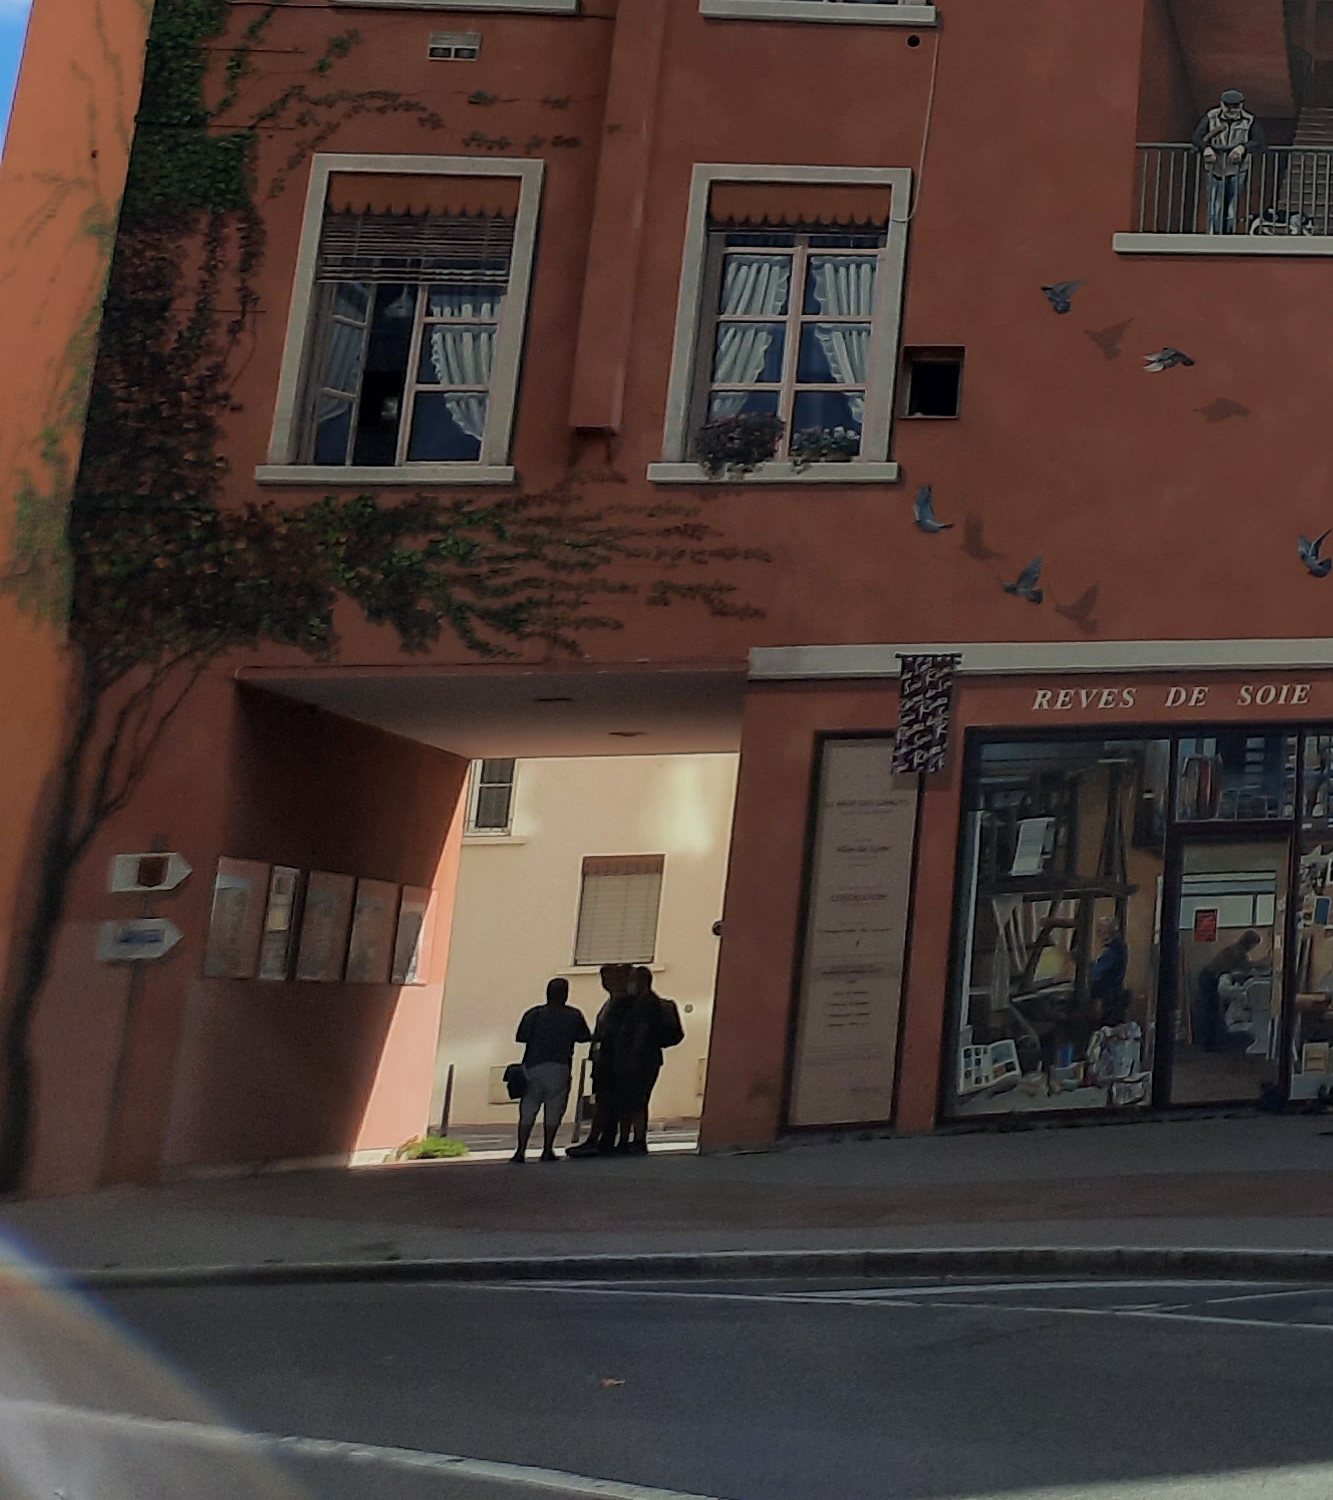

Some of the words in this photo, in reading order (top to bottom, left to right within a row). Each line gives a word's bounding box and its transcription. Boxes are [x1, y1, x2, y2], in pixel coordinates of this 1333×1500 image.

[1032, 687, 1137, 710] REVES
[1164, 686, 1209, 707] DE
[1237, 684, 1312, 707] SOIE
